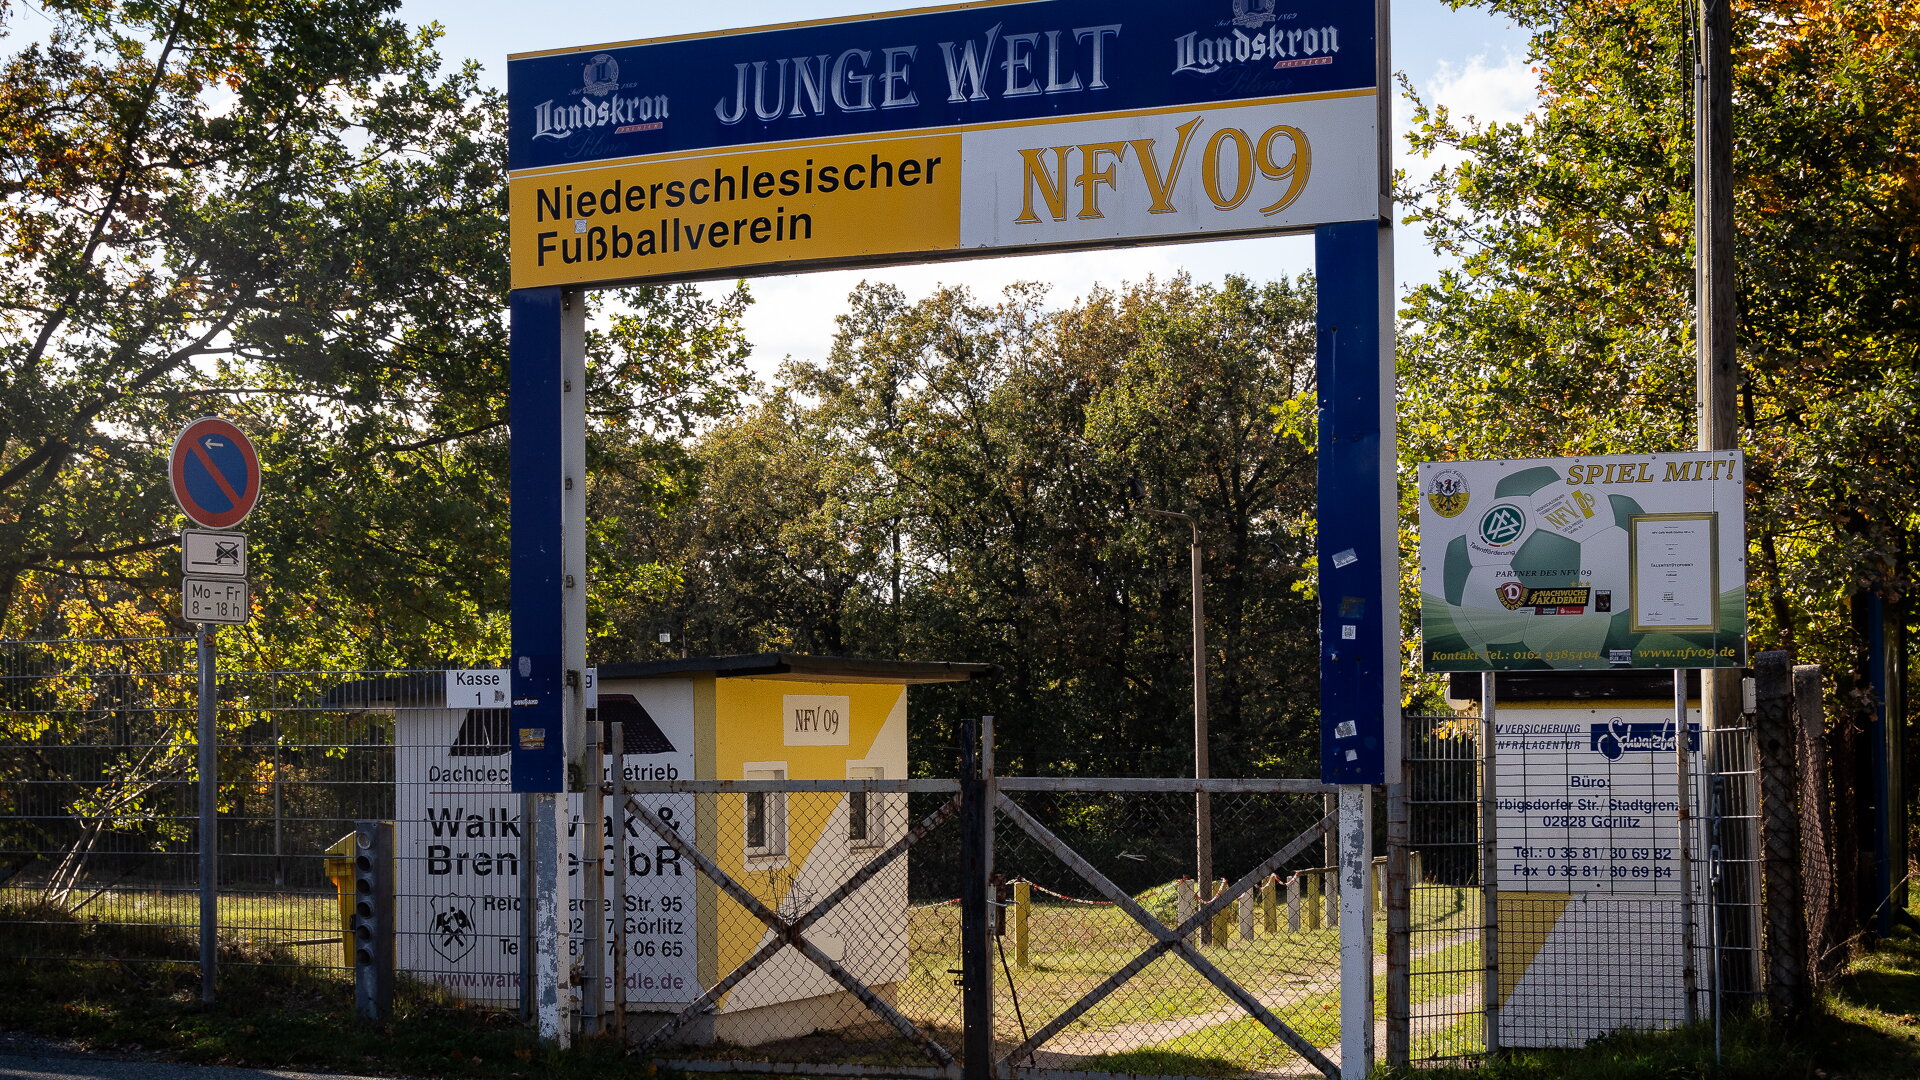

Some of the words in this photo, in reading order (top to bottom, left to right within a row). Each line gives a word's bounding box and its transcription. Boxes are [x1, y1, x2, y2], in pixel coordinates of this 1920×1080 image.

[1277, 13, 1298, 21] 1869
[1171, 24, 1340, 76] Landskron
[713, 45, 919, 126] JUNGE
[937, 21, 1123, 103] WELT
[531, 93, 670, 141] Landskron
[536, 153, 942, 223] Niederschlesischer
[536, 206, 813, 267] Fußballverein
[1565, 461, 1655, 486] SPIEL
[1663, 459, 1737, 483] MIT!
[1469, 541, 1516, 556] Talentförderung
[1495, 570, 1537, 578] PARTNER
[1540, 569, 1558, 577] DES
[1581, 569, 1592, 577] 09
[192, 583, 211, 599] Mo
[226, 586, 241, 601] Fr
[1539, 589, 1588, 597] NACHWUCHS
[1499, 595, 1527, 611] DRESDEN
[1535, 596, 1587, 605] AKADEMIE
[192, 601, 200, 615] 8
[216, 602, 228, 617] 18
[232, 603, 240, 618] h
[1431, 650, 1479, 661] Kontakt
[1484, 650, 1509, 660] Tel.:
[1513, 650, 1542, 660] 0162
[1639, 646, 1736, 660] www.nfv09.de
[456, 672, 500, 686] Kasse
[475, 691, 482, 705] 1
[794, 705, 822, 733] NFV
[823, 709, 840, 735] 09
[1505, 723, 1581, 733] VERSICHERUNG
[1570, 775, 1611, 788] Büro:
[1495, 798, 1574, 813] irbigsdorfer
[1608, 798, 1679, 814] Stadtgrenz
[657, 806, 681, 832] &
[1543, 816, 1587, 828] 02828
[1591, 815, 1641, 828] Görlitz
[1513, 846, 1543, 858] Tel.:
[1547, 847, 1556, 859] 0
[1631, 848, 1649, 860] 69
[1513, 864, 1539, 876] Fax
[1631, 866, 1649, 878] 69
[625, 895, 654, 912] Str.
[661, 896, 683, 912] 95
[624, 917, 684, 934] Görlitz
[633, 940, 656, 957] 06
[661, 940, 684, 957] 65
